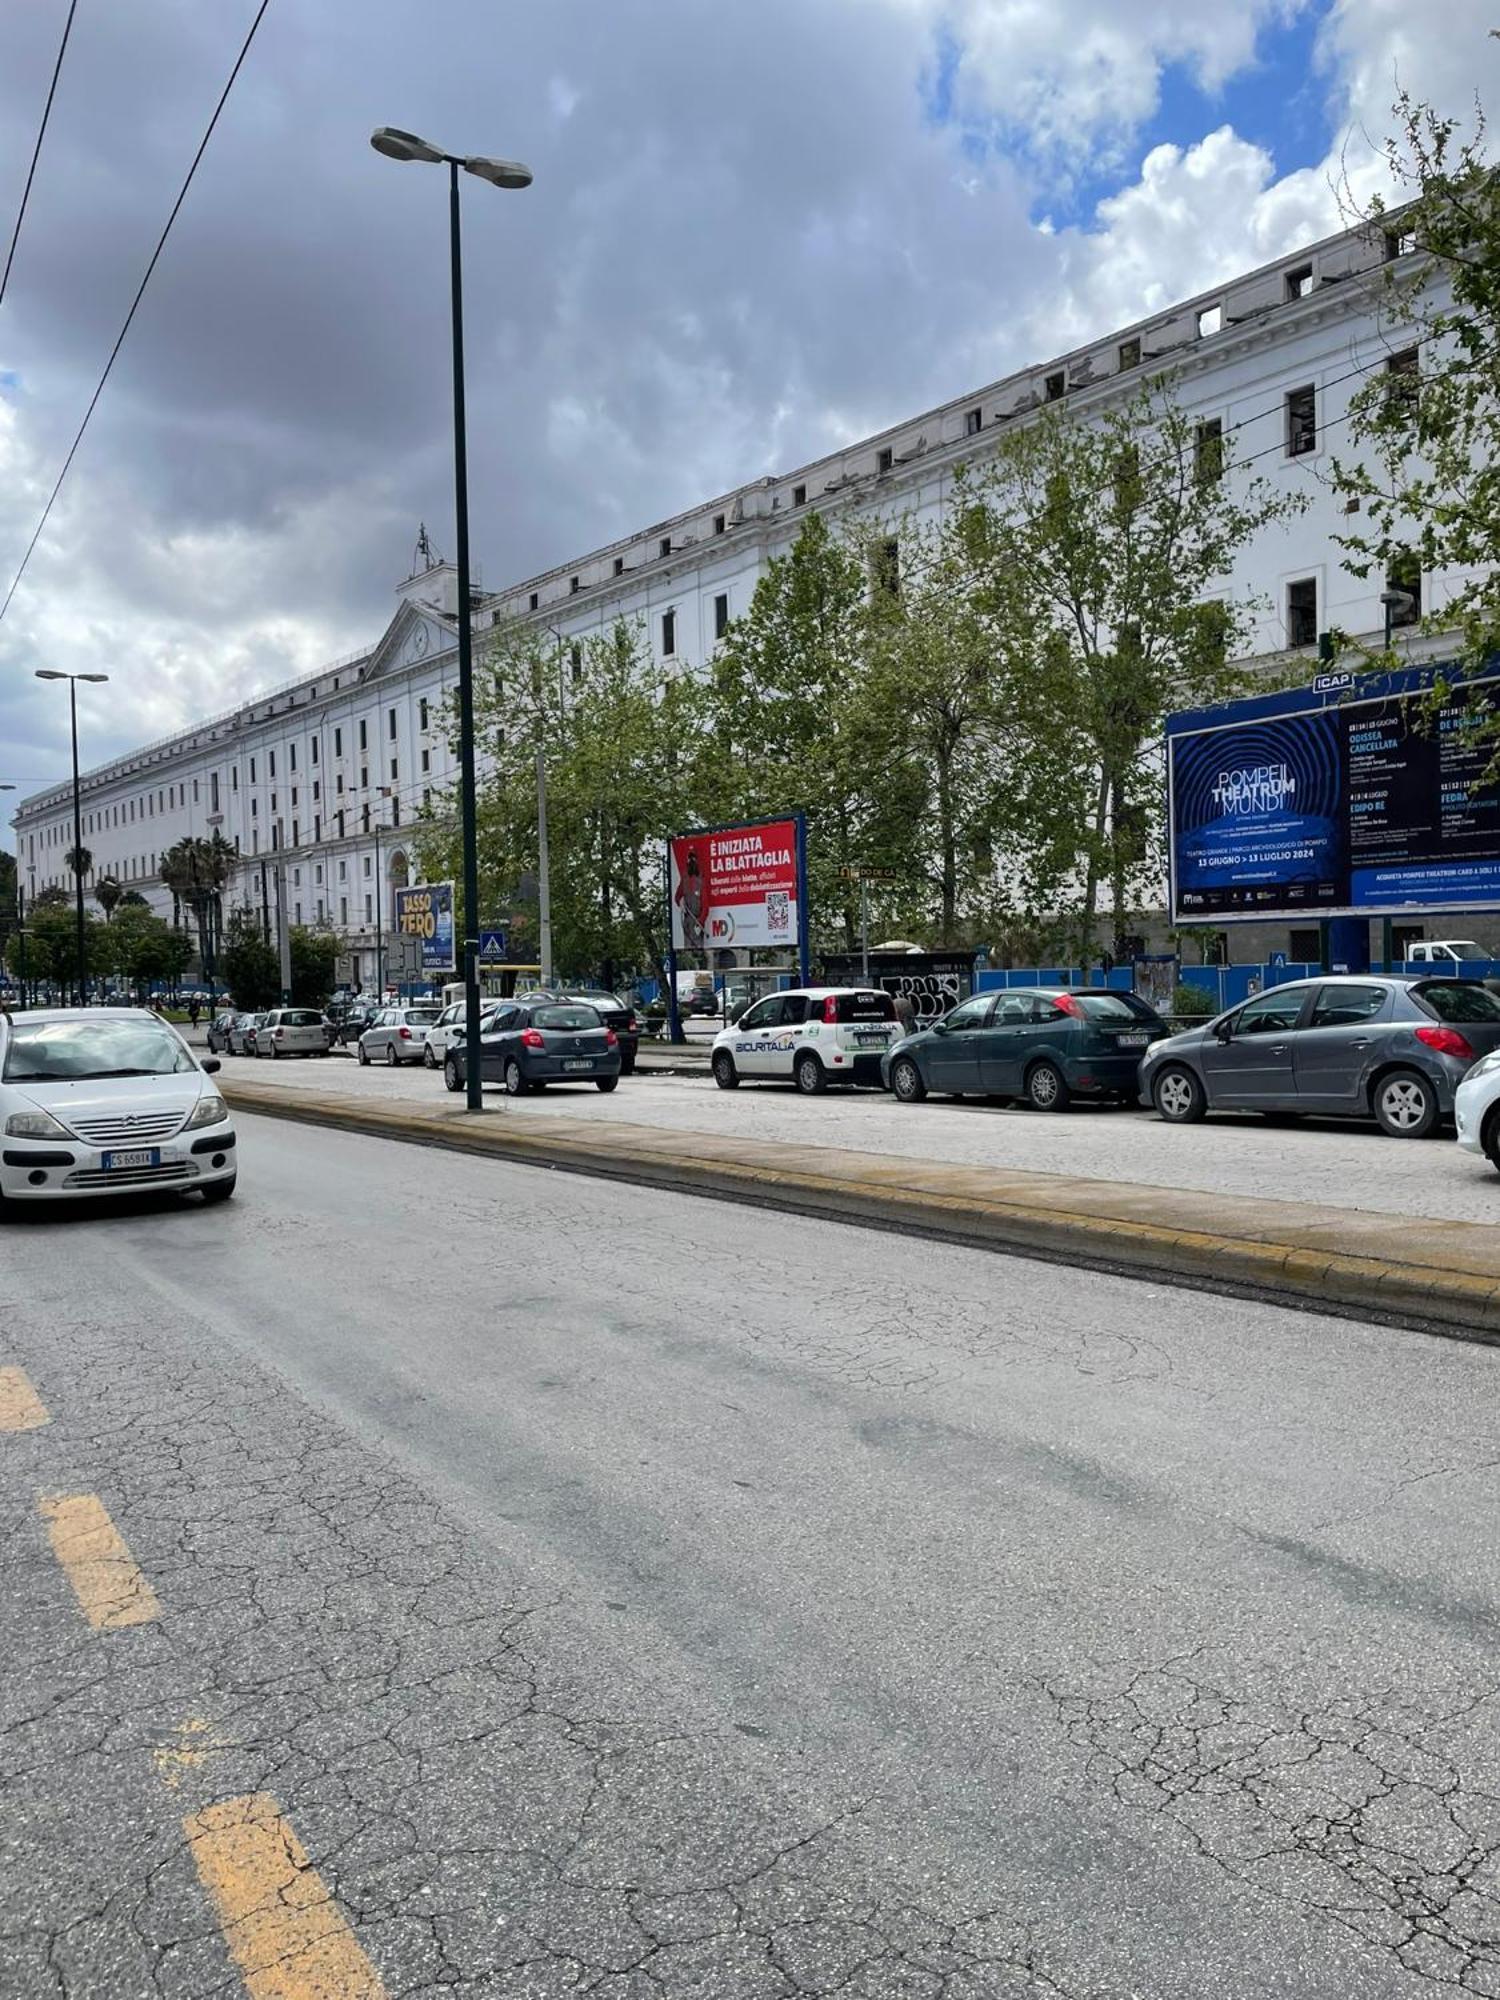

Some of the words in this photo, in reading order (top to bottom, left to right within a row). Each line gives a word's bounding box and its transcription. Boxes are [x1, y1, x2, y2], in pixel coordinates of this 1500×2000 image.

[1317, 674, 1350, 690] ICAP
[1440, 720, 1451, 730] DE
[1349, 731, 1383, 744] ODISSEA
[1349, 740, 1399, 754] CANCELLATA
[1212, 778, 1296, 803] THEATRUM
[1441, 791, 1468, 804] FEDRA
[1223, 793, 1284, 816] MUNDI
[1350, 803, 1374, 813] EDIPO
[710, 839, 718, 857] È
[718, 836, 763, 856] INIZIATA
[711, 859, 724, 873] LA
[725, 849, 791, 871] BLATTAGLIA
[1198, 858, 1207, 867] 13
[1208, 855, 1241, 867] GIUGNO
[1249, 854, 1258, 863] 13
[1260, 851, 1291, 862] LUGLIO
[1293, 849, 1315, 860] 2024
[402, 893, 432, 913] TASSO
[400, 911, 435, 939] ZERO
[712, 919, 728, 937] MD
[735, 1040, 795, 1053] SICURITALIA
